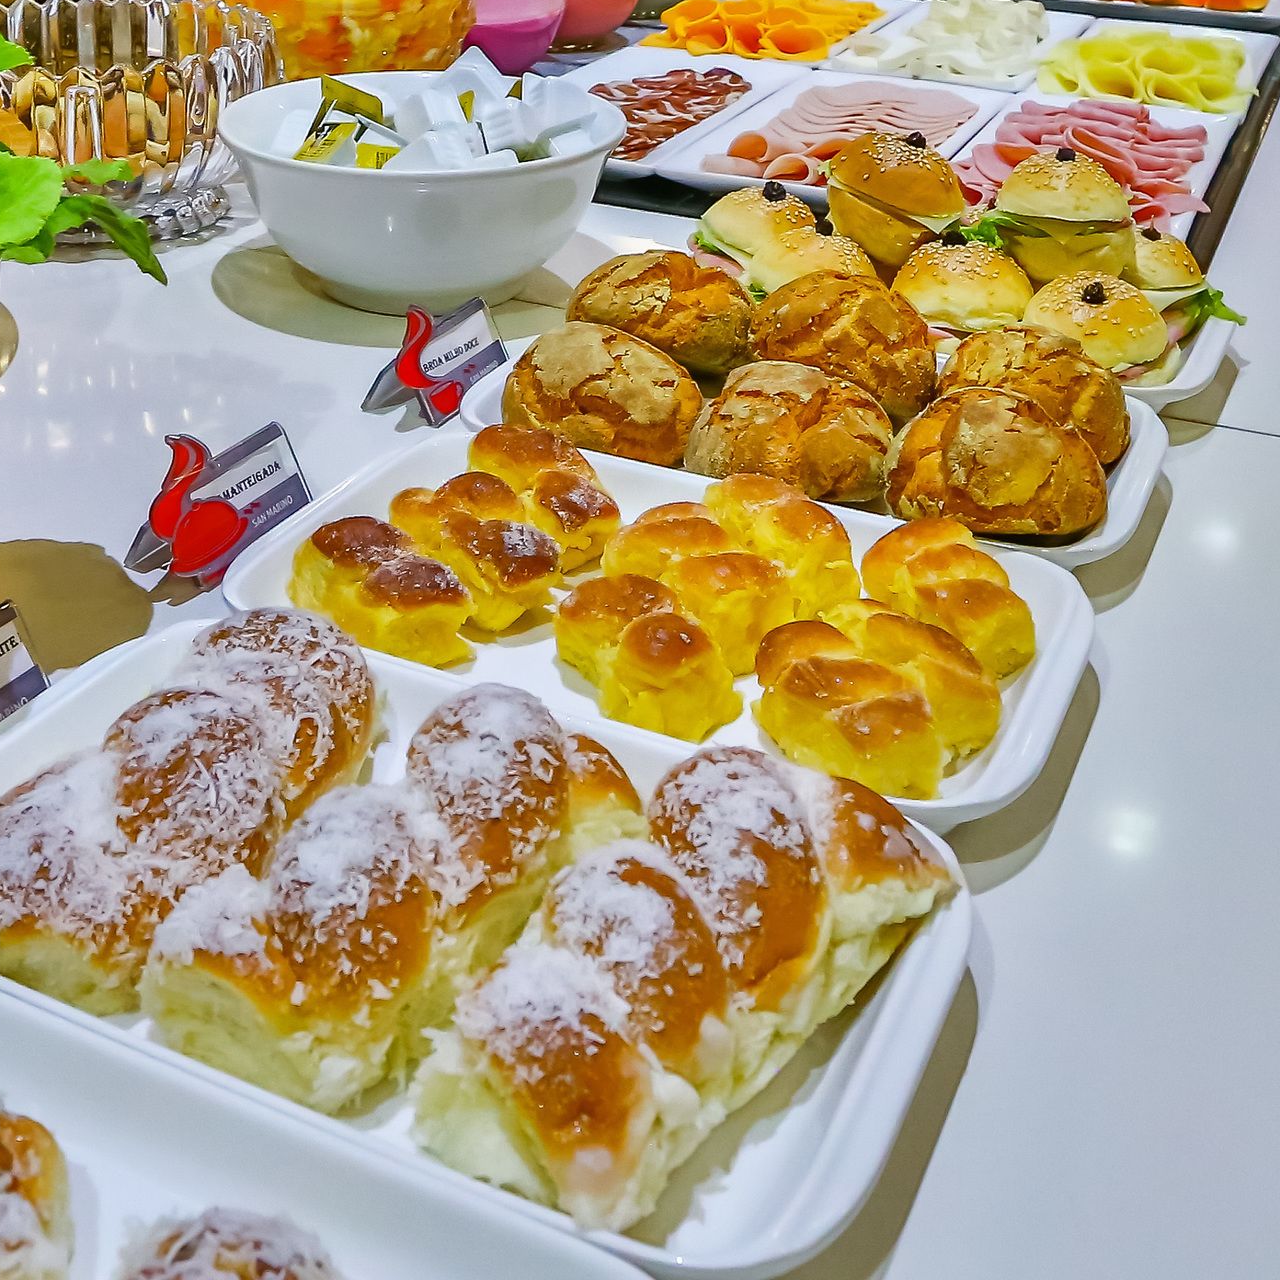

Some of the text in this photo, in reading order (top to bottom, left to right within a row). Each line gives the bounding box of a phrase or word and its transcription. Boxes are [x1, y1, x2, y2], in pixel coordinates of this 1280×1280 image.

[423, 357, 445, 373] BROA
[251, 495, 293, 528] SAN MARINO
